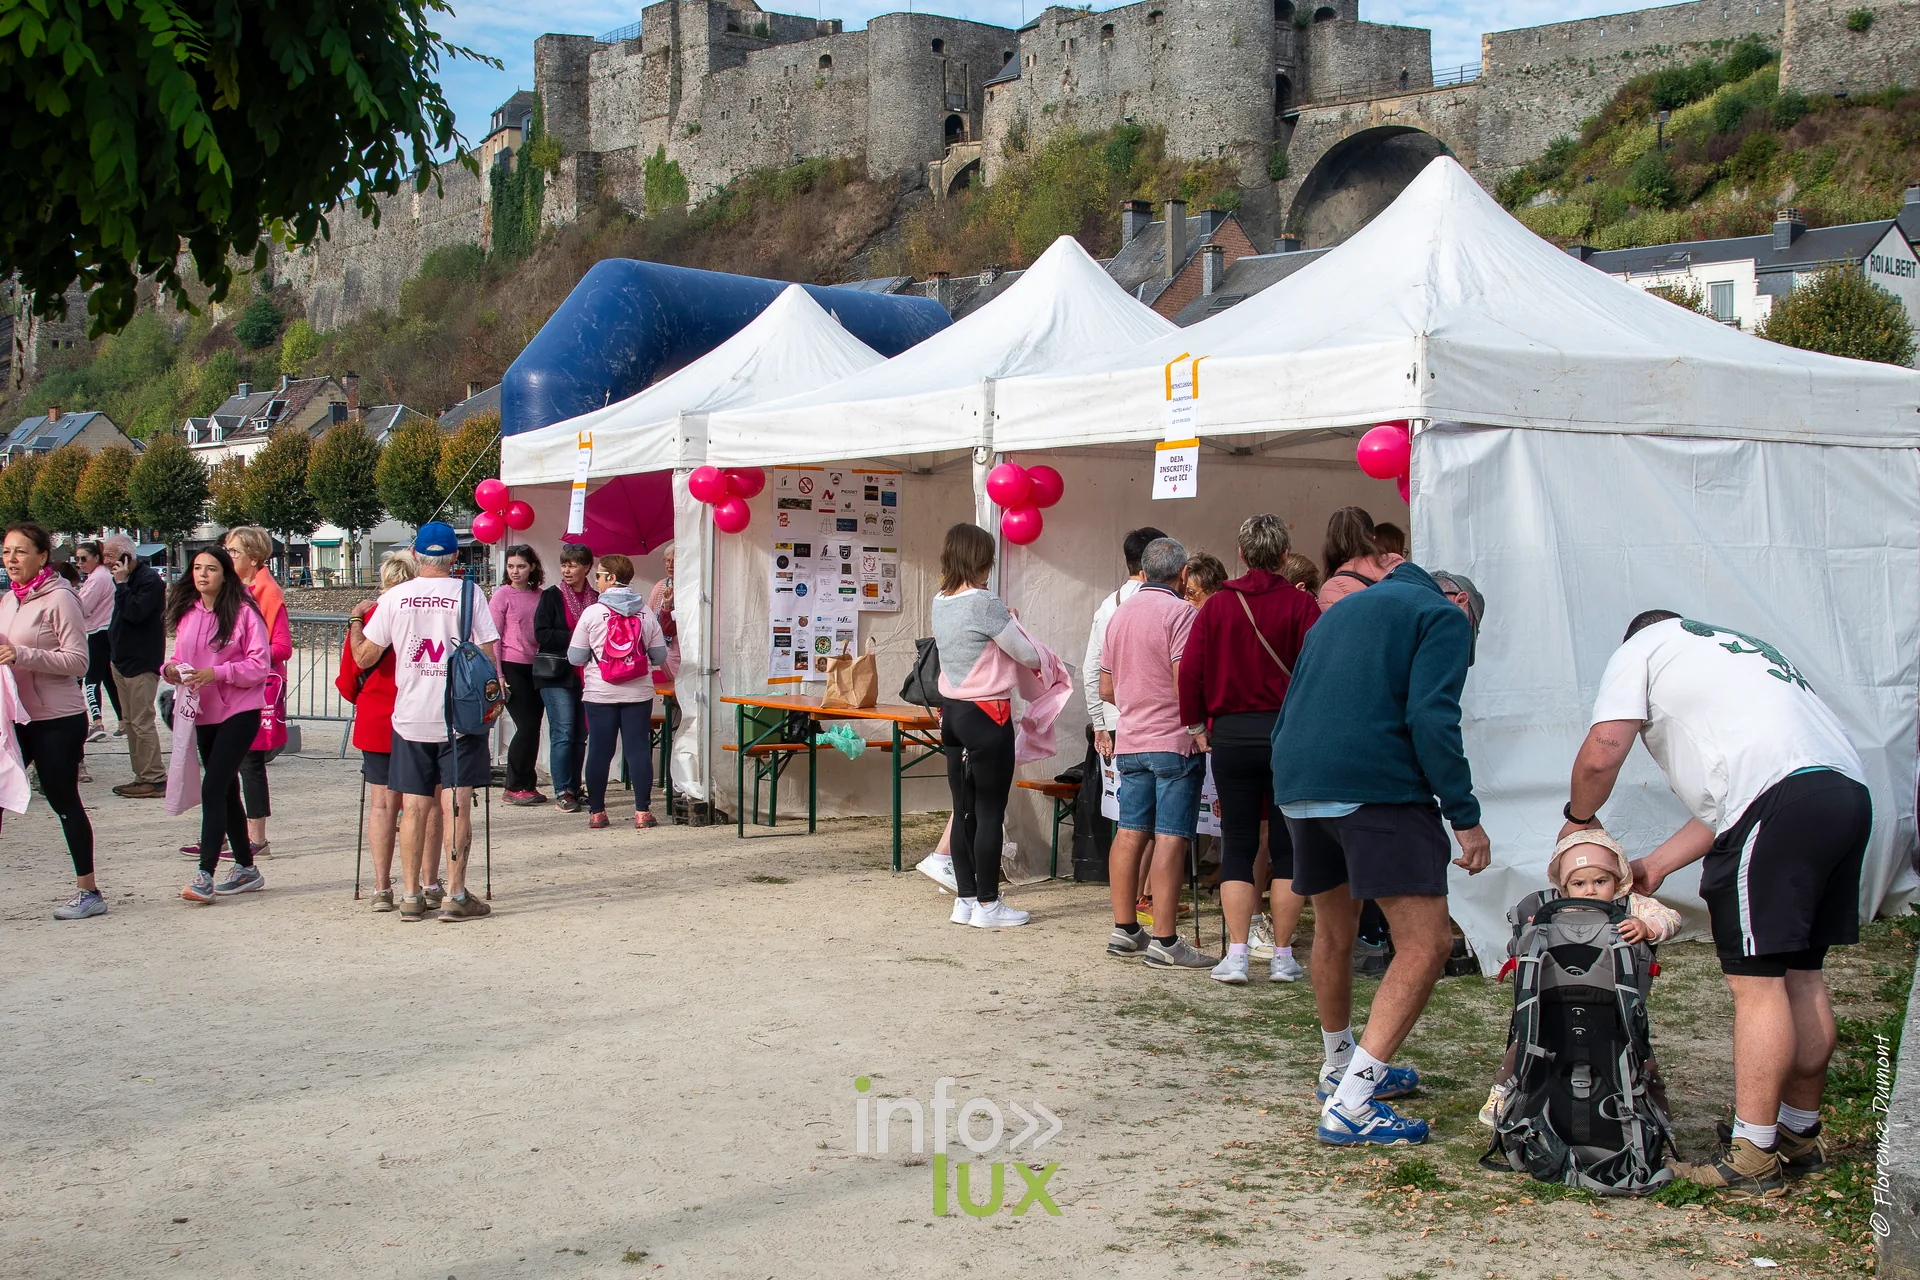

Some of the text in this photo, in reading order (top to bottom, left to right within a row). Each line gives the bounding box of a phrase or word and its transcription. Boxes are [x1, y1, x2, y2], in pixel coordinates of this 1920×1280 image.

[1870, 254, 1917, 279] ROI ALBERT
[1169, 455, 1184, 463] DEJA
[1178, 473, 1188, 481] ICI
[401, 597, 458, 609] PIERRET
